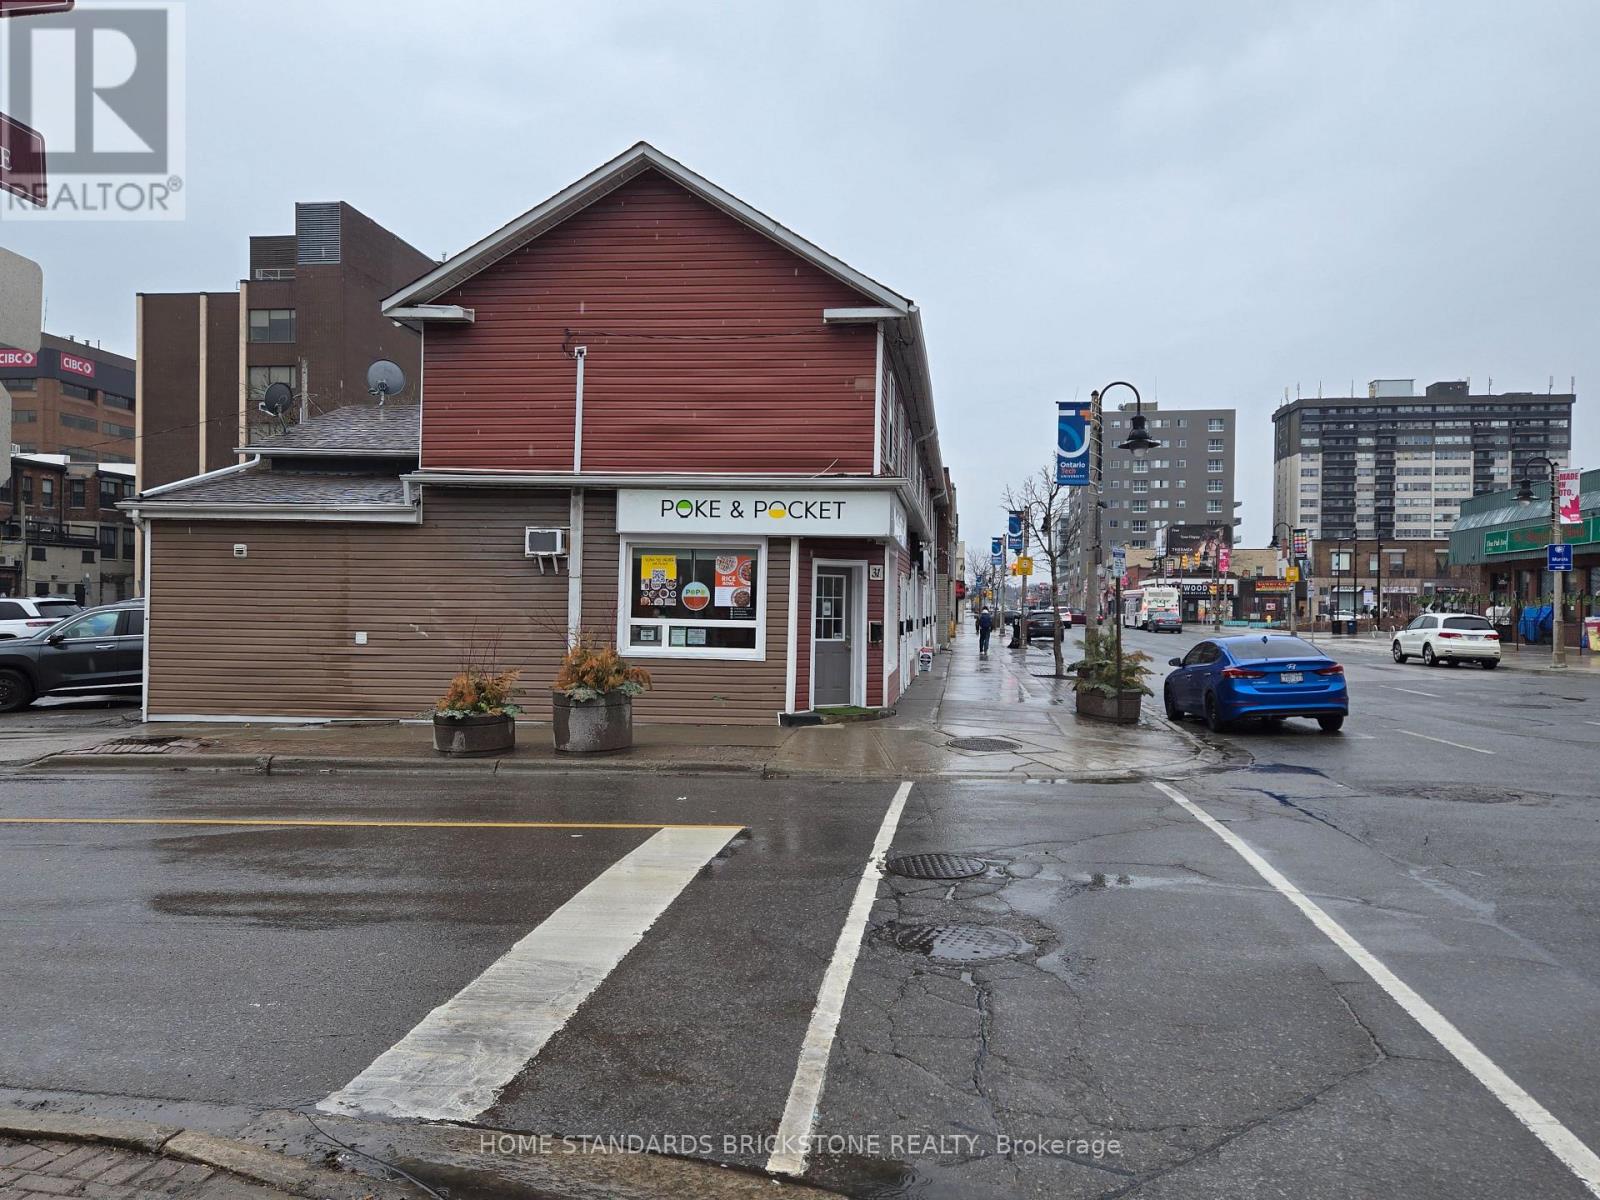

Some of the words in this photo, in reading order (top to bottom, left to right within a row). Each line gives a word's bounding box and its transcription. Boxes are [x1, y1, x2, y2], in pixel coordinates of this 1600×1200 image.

[0, 353, 22, 364] CIBC
[63, 357, 83, 371] CIBC
[1559, 472, 1579, 480] MADE
[661, 499, 721, 518] POKE
[730, 500, 744, 518] &
[754, 500, 846, 519] POCKET
